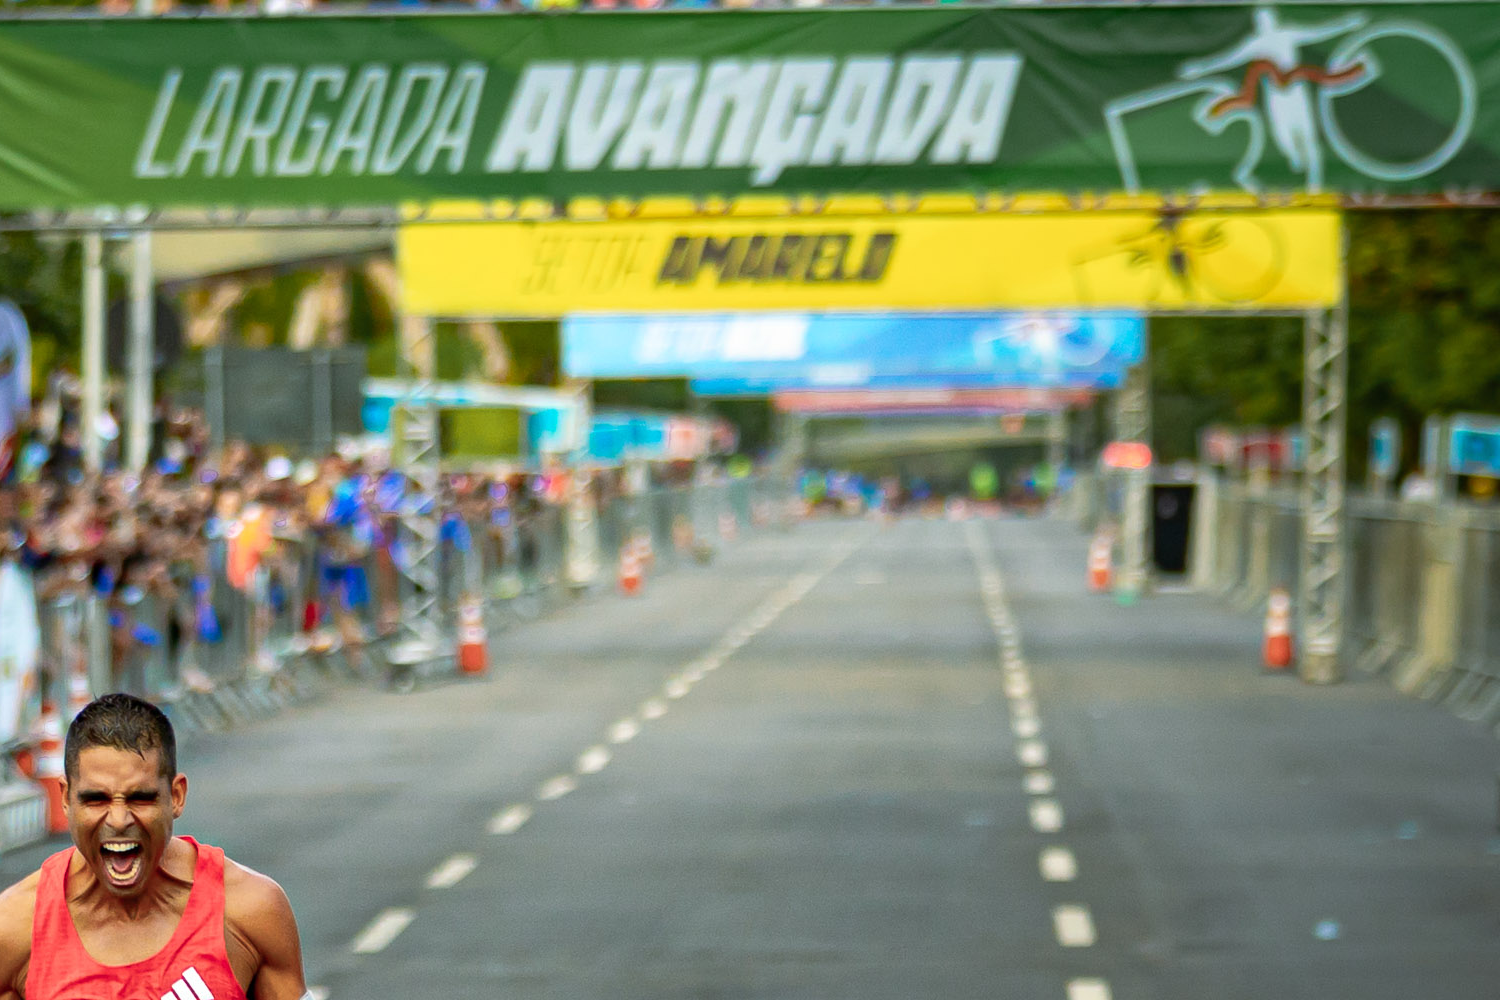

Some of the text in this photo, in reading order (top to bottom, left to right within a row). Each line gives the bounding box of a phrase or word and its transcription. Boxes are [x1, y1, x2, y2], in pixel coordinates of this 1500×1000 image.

[134, 55, 1022, 186] LARGADA AVANÇADA
[654, 234, 897, 286] AMARELO
